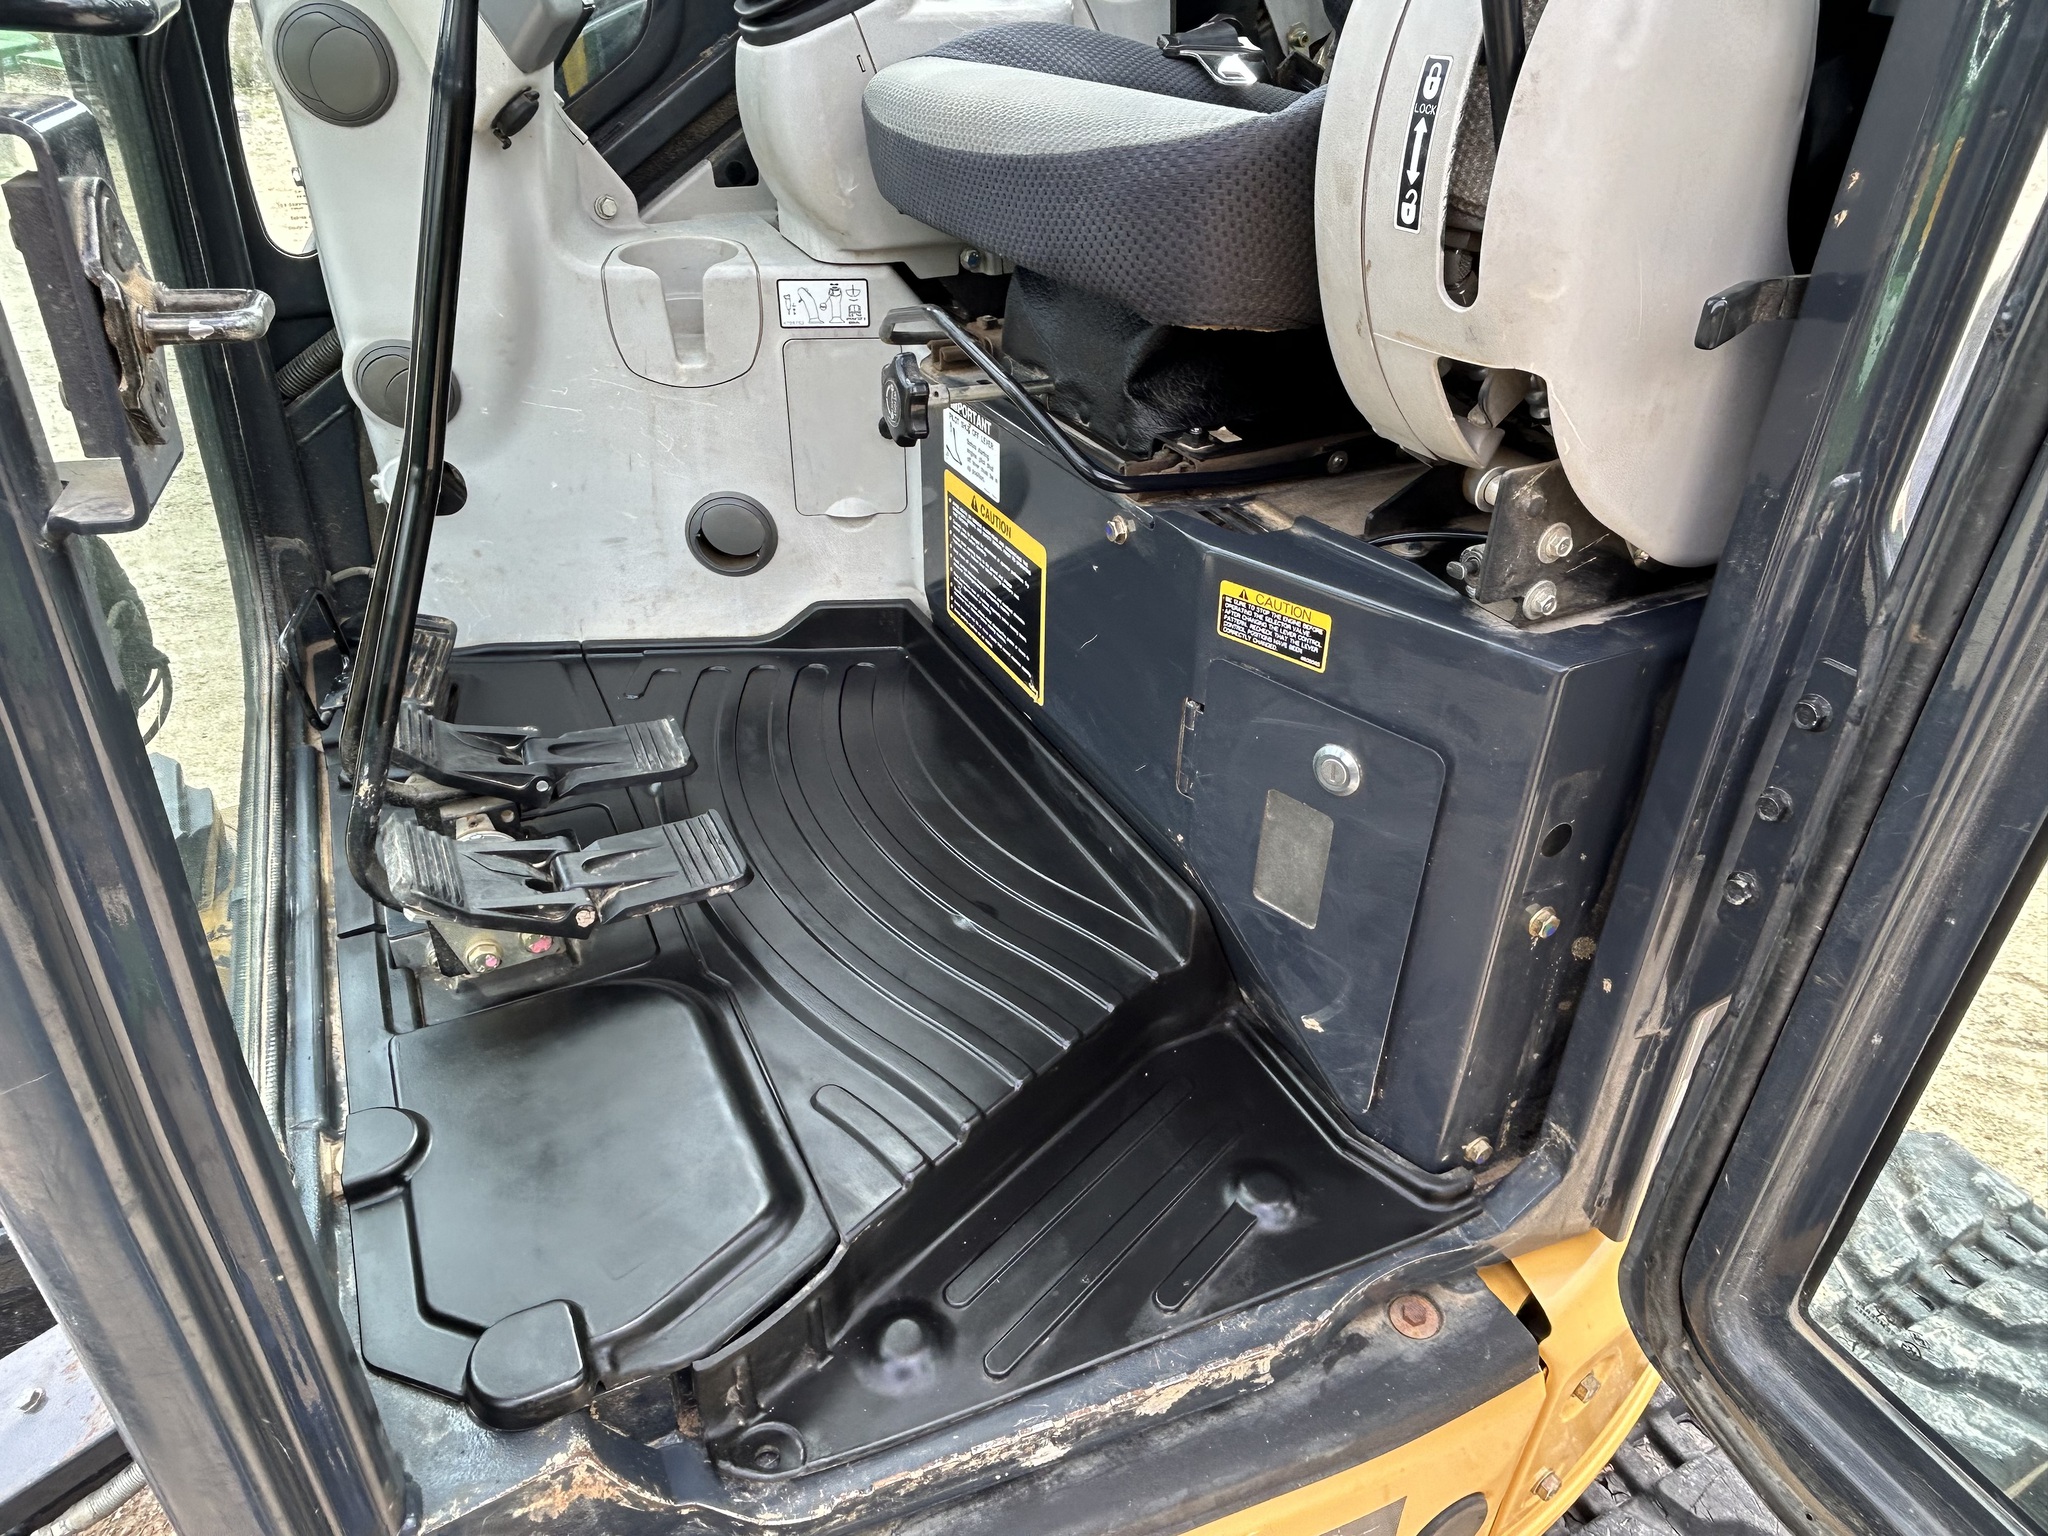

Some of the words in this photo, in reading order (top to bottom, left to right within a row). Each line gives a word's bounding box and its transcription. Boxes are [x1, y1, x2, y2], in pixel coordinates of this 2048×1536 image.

[1414, 103, 1437, 116] LOCK
[950, 402, 992, 436] PORTANT
[980, 503, 1012, 539] CAUTION
[1256, 594, 1312, 622] CAUTION
[1256, 607, 1270, 615] STOP
